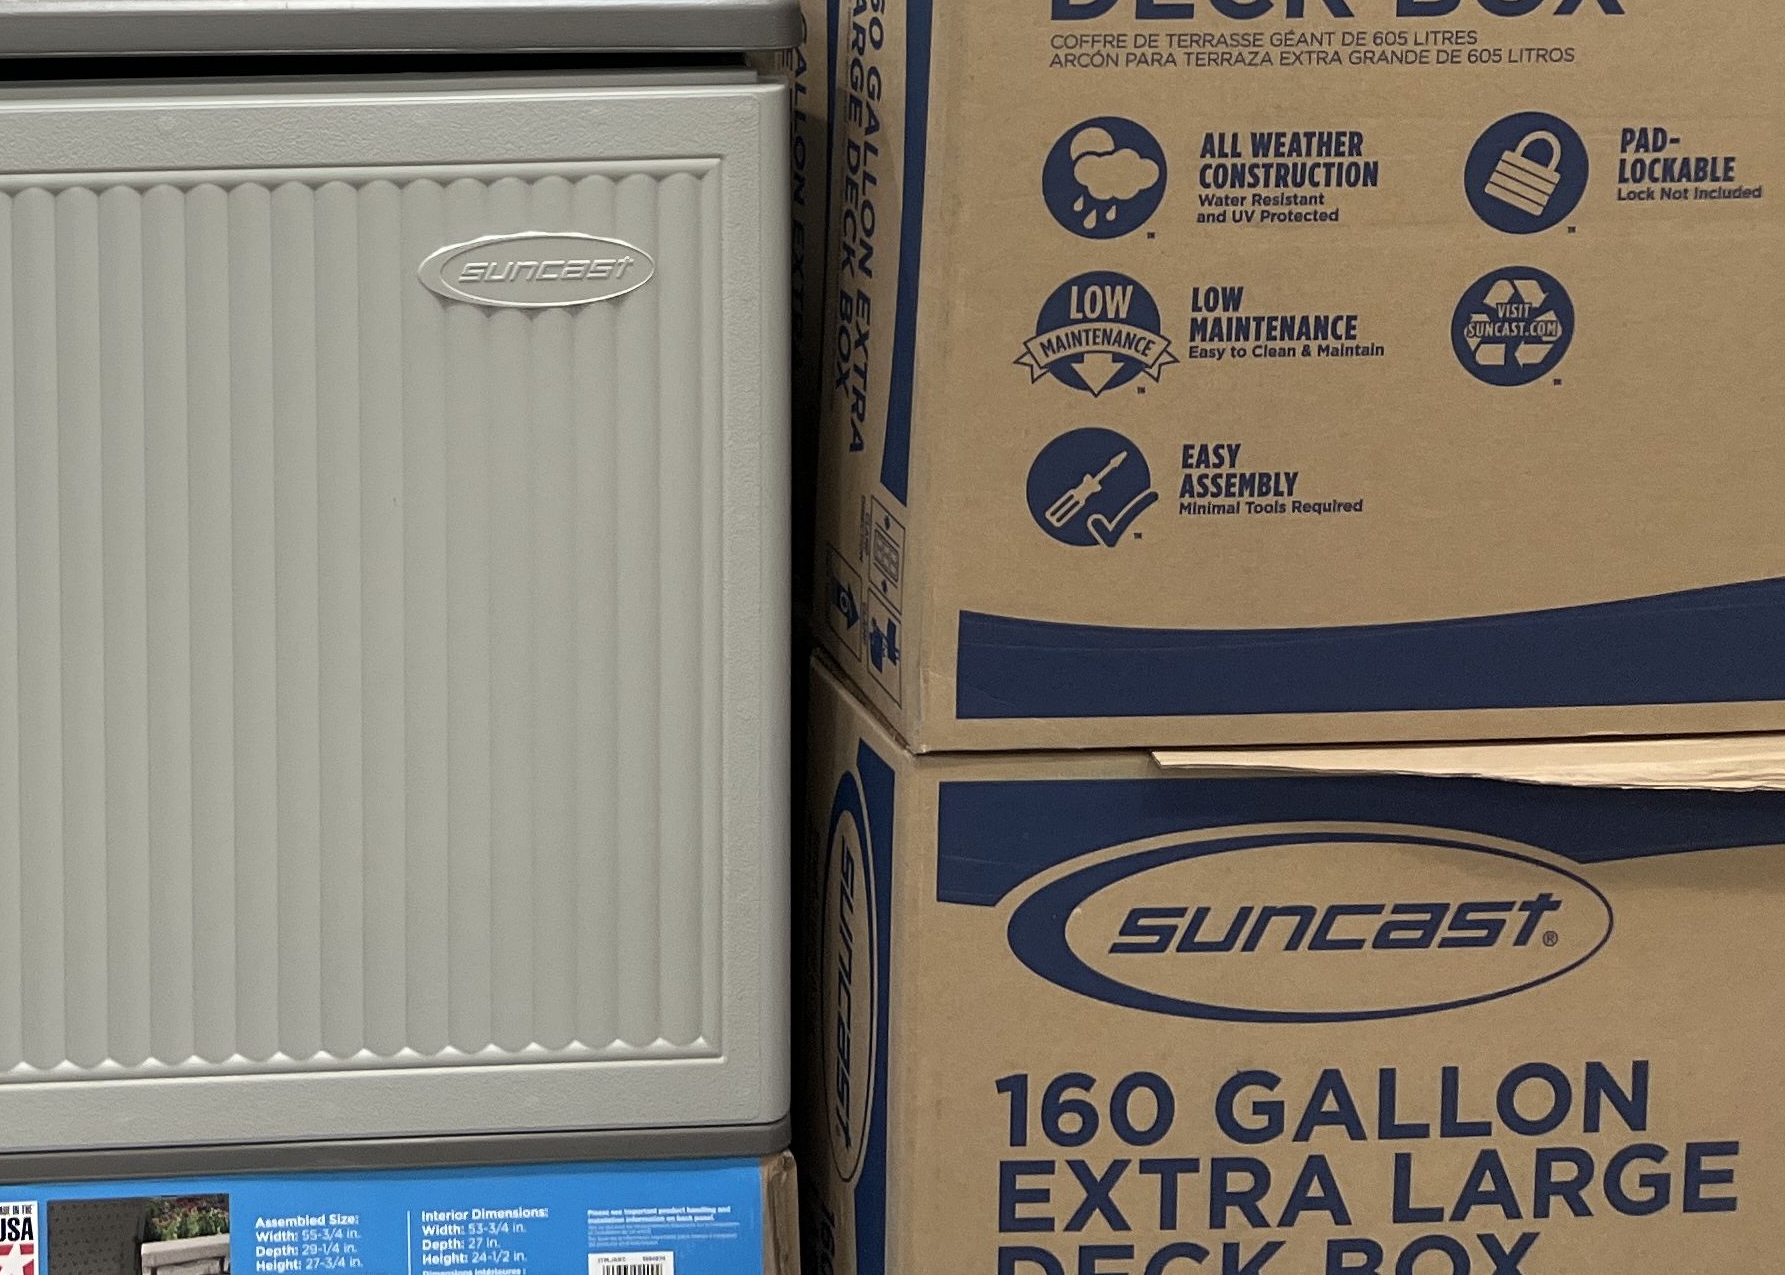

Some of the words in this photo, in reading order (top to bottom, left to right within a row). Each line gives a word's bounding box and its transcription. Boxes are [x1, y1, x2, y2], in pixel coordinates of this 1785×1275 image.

[1050, 32, 1129, 51] COFFRE
[1133, 32, 1160, 50] DE
[1164, 30, 1263, 49] TERRASSE
[1267, 26, 1334, 49] GÉANT
[1341, 30, 1368, 48] DE
[1372, 29, 1409, 48] 605
[1414, 29, 1479, 48] LITRES
[1049, 48, 1121, 70] ARCÓN
[1124, 51, 1179, 69] PARA
[1183, 50, 1274, 68] TERRAZA
[1279, 49, 1344, 67] EXTRA
[1348, 48, 1431, 66] GRANDE
[1435, 48, 1463, 65] DE
[1466, 47, 1504, 65] 605
[1508, 46, 1576, 65] LITROS
[1199, 132, 1245, 160] ALL
[1249, 131, 1365, 159] WEATHER
[1620, 127, 1682, 155] PAD-
[858, 66, 883, 279] GALLON
[1198, 160, 1380, 190] CONSTRUCTION
[1617, 155, 1736, 184] LOCKABLE
[1198, 192, 1246, 209] Water
[1251, 191, 1325, 208] Resistant
[1617, 185, 1654, 202] Lock
[1659, 185, 1689, 202] Not
[1693, 183, 1764, 201] Included
[839, 138, 861, 280] DECK
[1196, 209, 1227, 225] and
[1231, 208, 1256, 224] UV
[1259, 206, 1340, 224] Protected
[458, 254, 634, 283] suncast
[1068, 284, 1134, 320] LOW
[1191, 286, 1245, 314] LOW
[1495, 302, 1533, 319] VISIT
[1188, 314, 1359, 342] MAINTENANCE
[1465, 319, 1561, 339] SUNCAST.COM
[834, 290, 854, 396] BOX
[1038, 328, 1157, 359] MAINTENANCE
[1188, 344, 1225, 363] Easy
[1229, 344, 1247, 360] to
[1251, 342, 1298, 360] Clean
[1301, 342, 1314, 359] &
[1317, 340, 1386, 359] Maintain
[849, 289, 872, 453] EXTRA
[1180, 442, 1242, 470] EASY
[1179, 471, 1300, 499] ASSEMBLY
[1178, 499, 1242, 516] Minimal
[1245, 499, 1287, 516] Tools
[1291, 498, 1364, 516] Required
[1108, 893, 1563, 956] suncast
[835, 835, 856, 1150] suncast
[995, 1070, 1176, 1149] 160
[1215, 1058, 1651, 1146] GALLON
[996, 1155, 1353, 1233] EXTRA
[1392, 1141, 1741, 1225] LARGE
[21, 1204, 33, 1215] THE
[255, 1215, 327, 1229] Assembled
[329, 1214, 360, 1226] Size:
[421, 1209, 470, 1222] Interior
[471, 1207, 550, 1221] Dimensions:
[256, 1230, 299, 1243] Width:
[421, 1223, 466, 1237] Width:
[468, 1222, 509, 1235] 53-3/4
[256, 1244, 299, 1259] Depth:
[301, 1243, 341, 1256] 29-1/4
[422, 1238, 466, 1252] Depth:
[468, 1237, 484, 1250] 27
[422, 1252, 469, 1267] Height:
[471, 1250, 511, 1264] 24-1/2
[256, 1259, 303, 1274] Height:
[305, 1258, 347, 1271] 27-3/4
